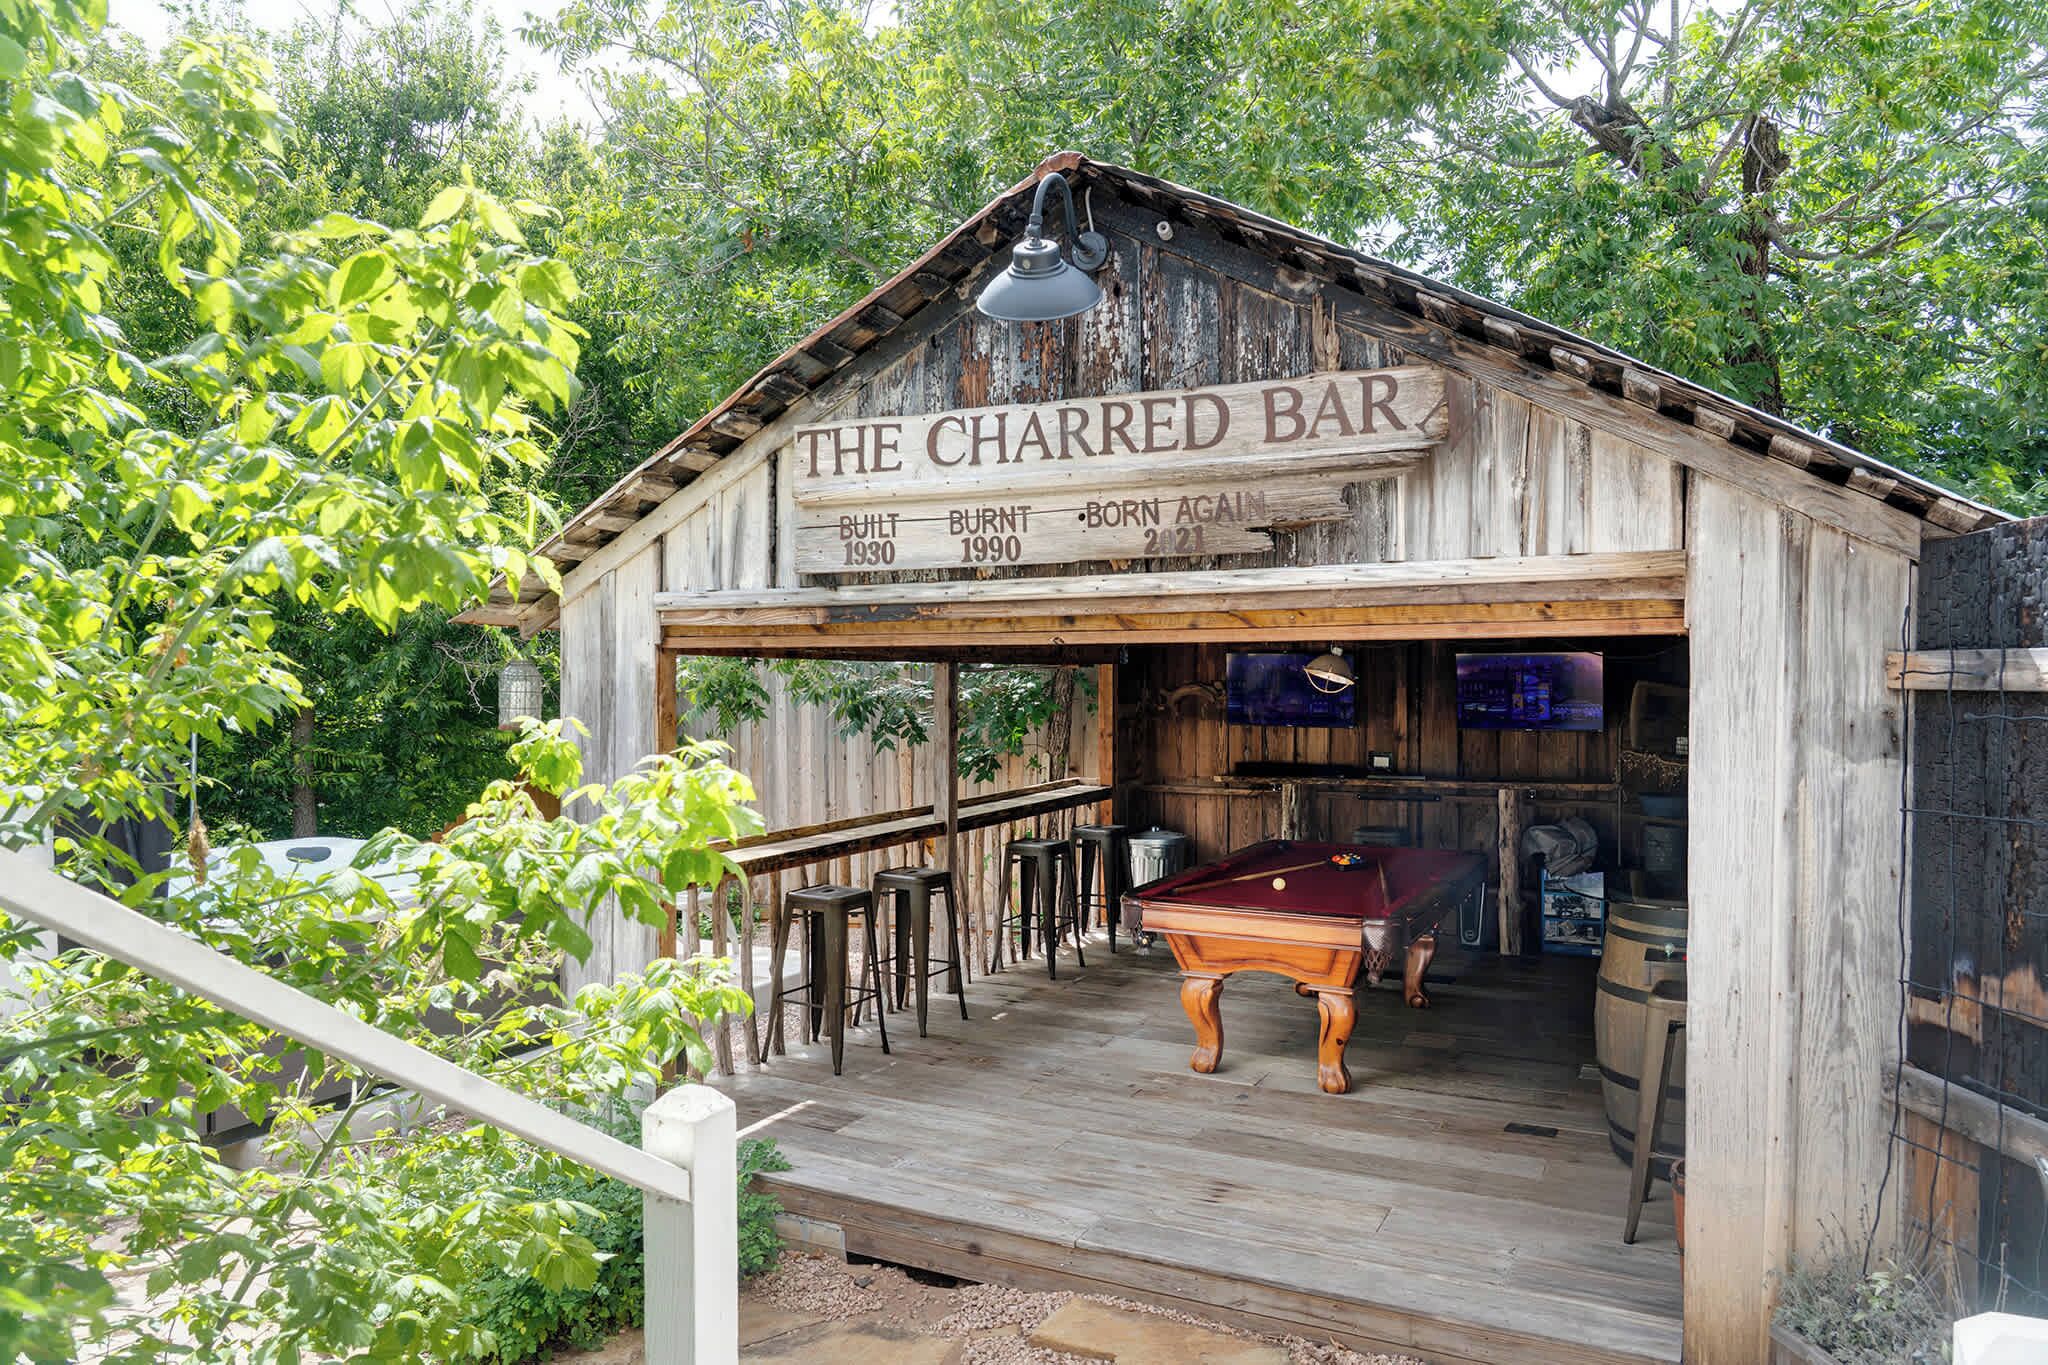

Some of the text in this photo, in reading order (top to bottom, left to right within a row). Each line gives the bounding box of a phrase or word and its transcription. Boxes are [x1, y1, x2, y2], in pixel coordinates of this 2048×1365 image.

[797, 423, 902, 478] THE
[926, 392, 1231, 466] CHARRED
[949, 505, 1032, 536] BURNT
[1086, 490, 1265, 528] BORN AGAIN
[839, 513, 899, 541] BUILT
[1144, 524, 1204, 555] 2021
[843, 540, 896, 566] 1930
[961, 535, 1022, 563] 1990
